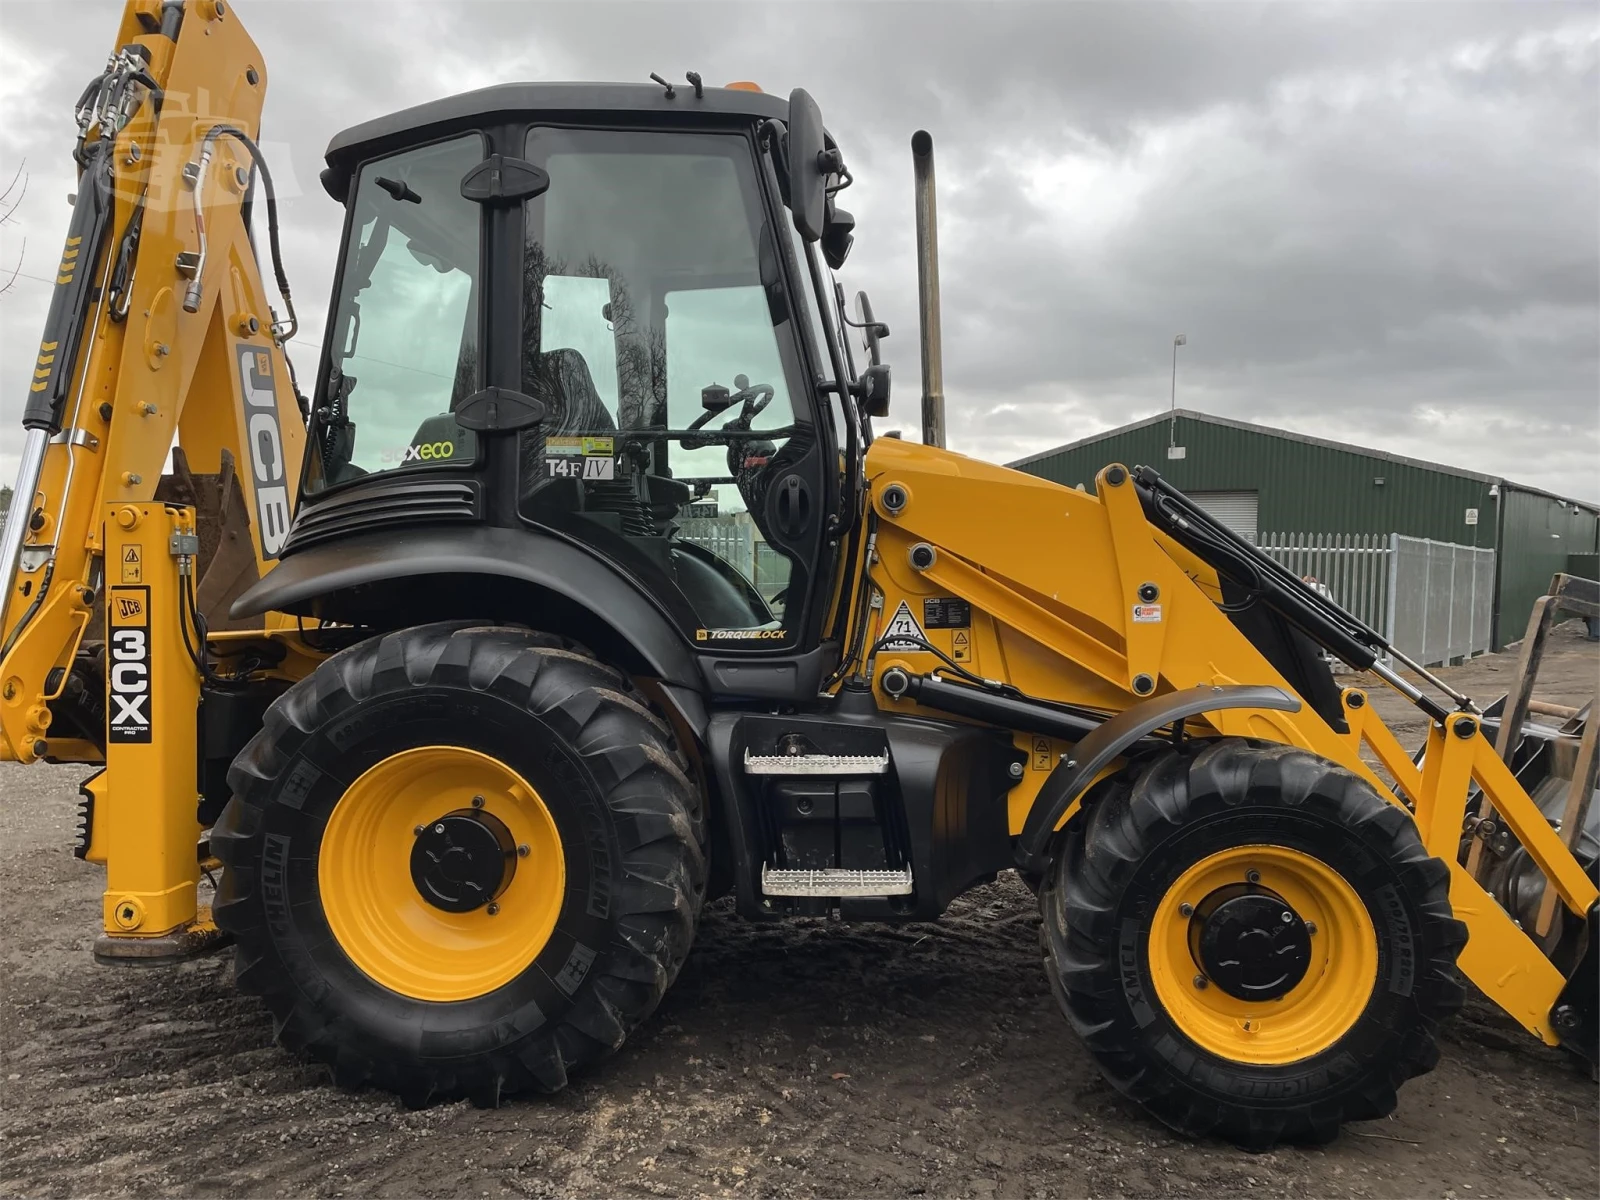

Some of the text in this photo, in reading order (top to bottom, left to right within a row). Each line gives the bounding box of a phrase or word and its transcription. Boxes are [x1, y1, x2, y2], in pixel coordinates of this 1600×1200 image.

[241, 351, 292, 555] JCB
[120, 599, 141, 616] JCB
[896, 620, 911, 633] 71
[111, 630, 149, 724] 3CX
